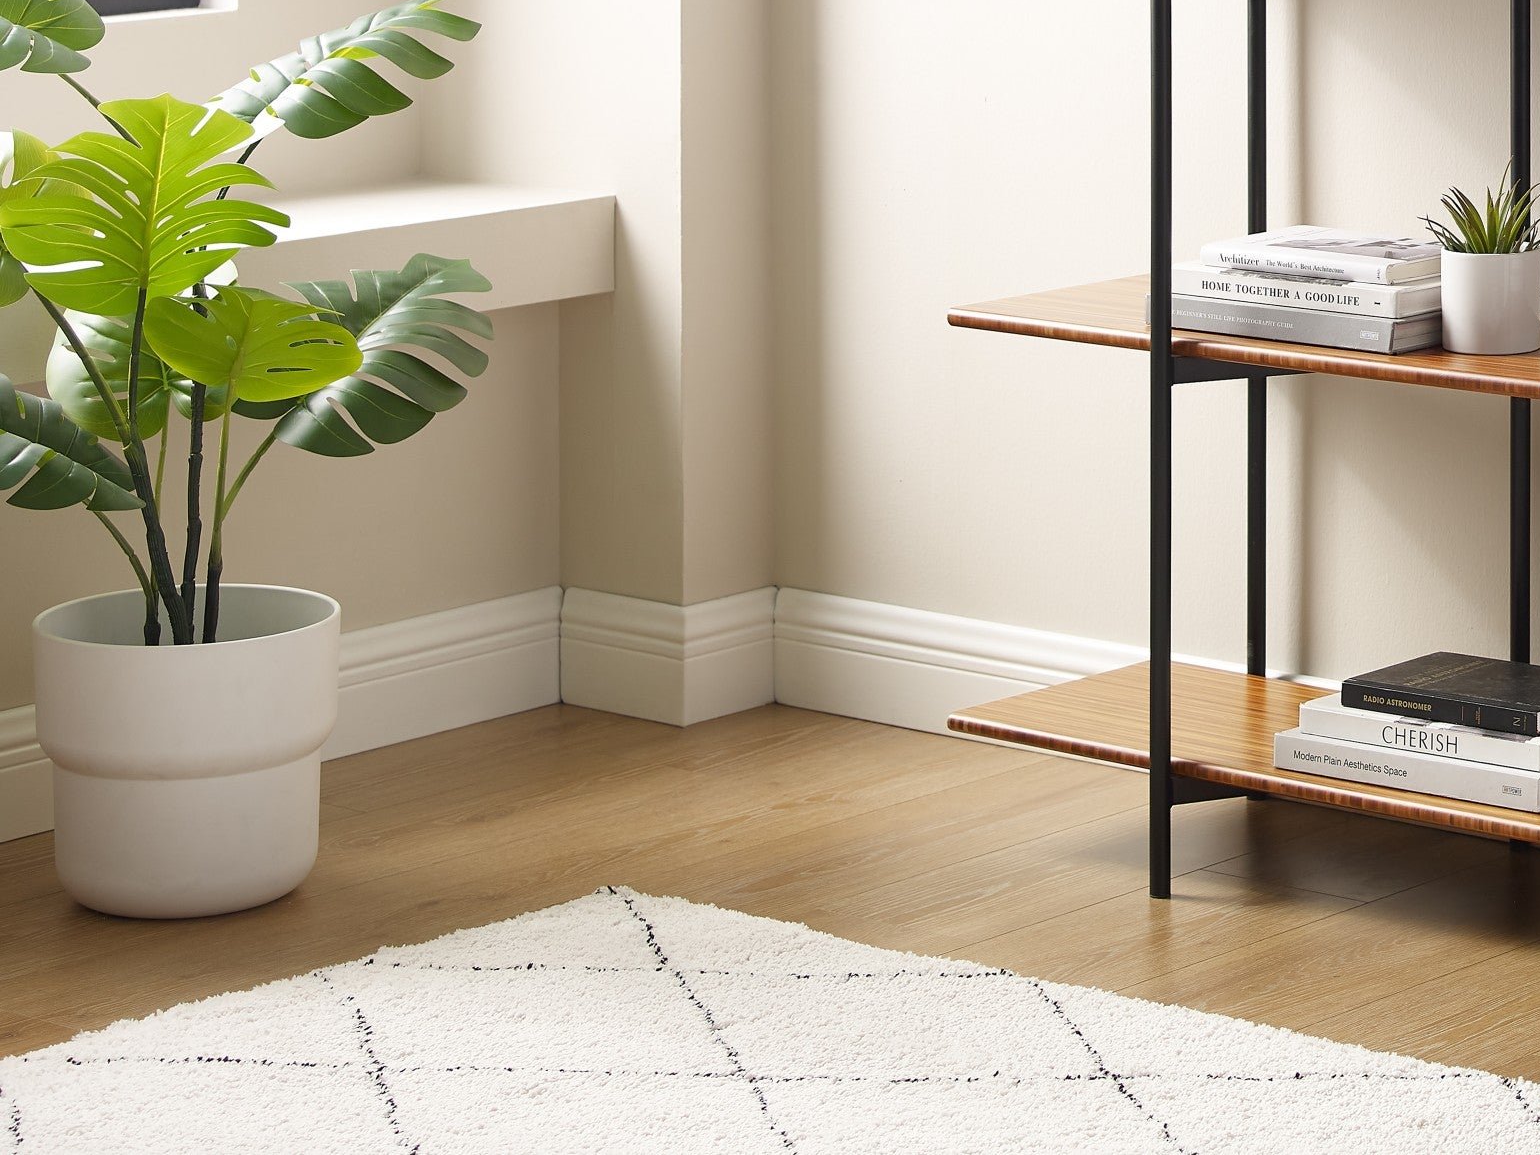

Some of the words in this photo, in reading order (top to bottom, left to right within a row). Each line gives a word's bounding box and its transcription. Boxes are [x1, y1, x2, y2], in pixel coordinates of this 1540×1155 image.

[1219, 253, 1260, 266] Architizer
[1201, 280, 1231, 292] HOME
[1235, 284, 1290, 299] TOGETHER
[1294, 291, 1301, 300] A
[1305, 291, 1335, 303] GOOD
[1337, 294, 1360, 306] LIFE
[1363, 694, 1385, 705] RADIO
[1386, 698, 1432, 712] ASTRONOMER
[1382, 725, 1458, 754] CHERISH
[1293, 749, 1322, 763] Modern
[1323, 754, 1342, 767] Plain
[1343, 758, 1382, 774] Aesthetics
[1383, 765, 1408, 777] Space
